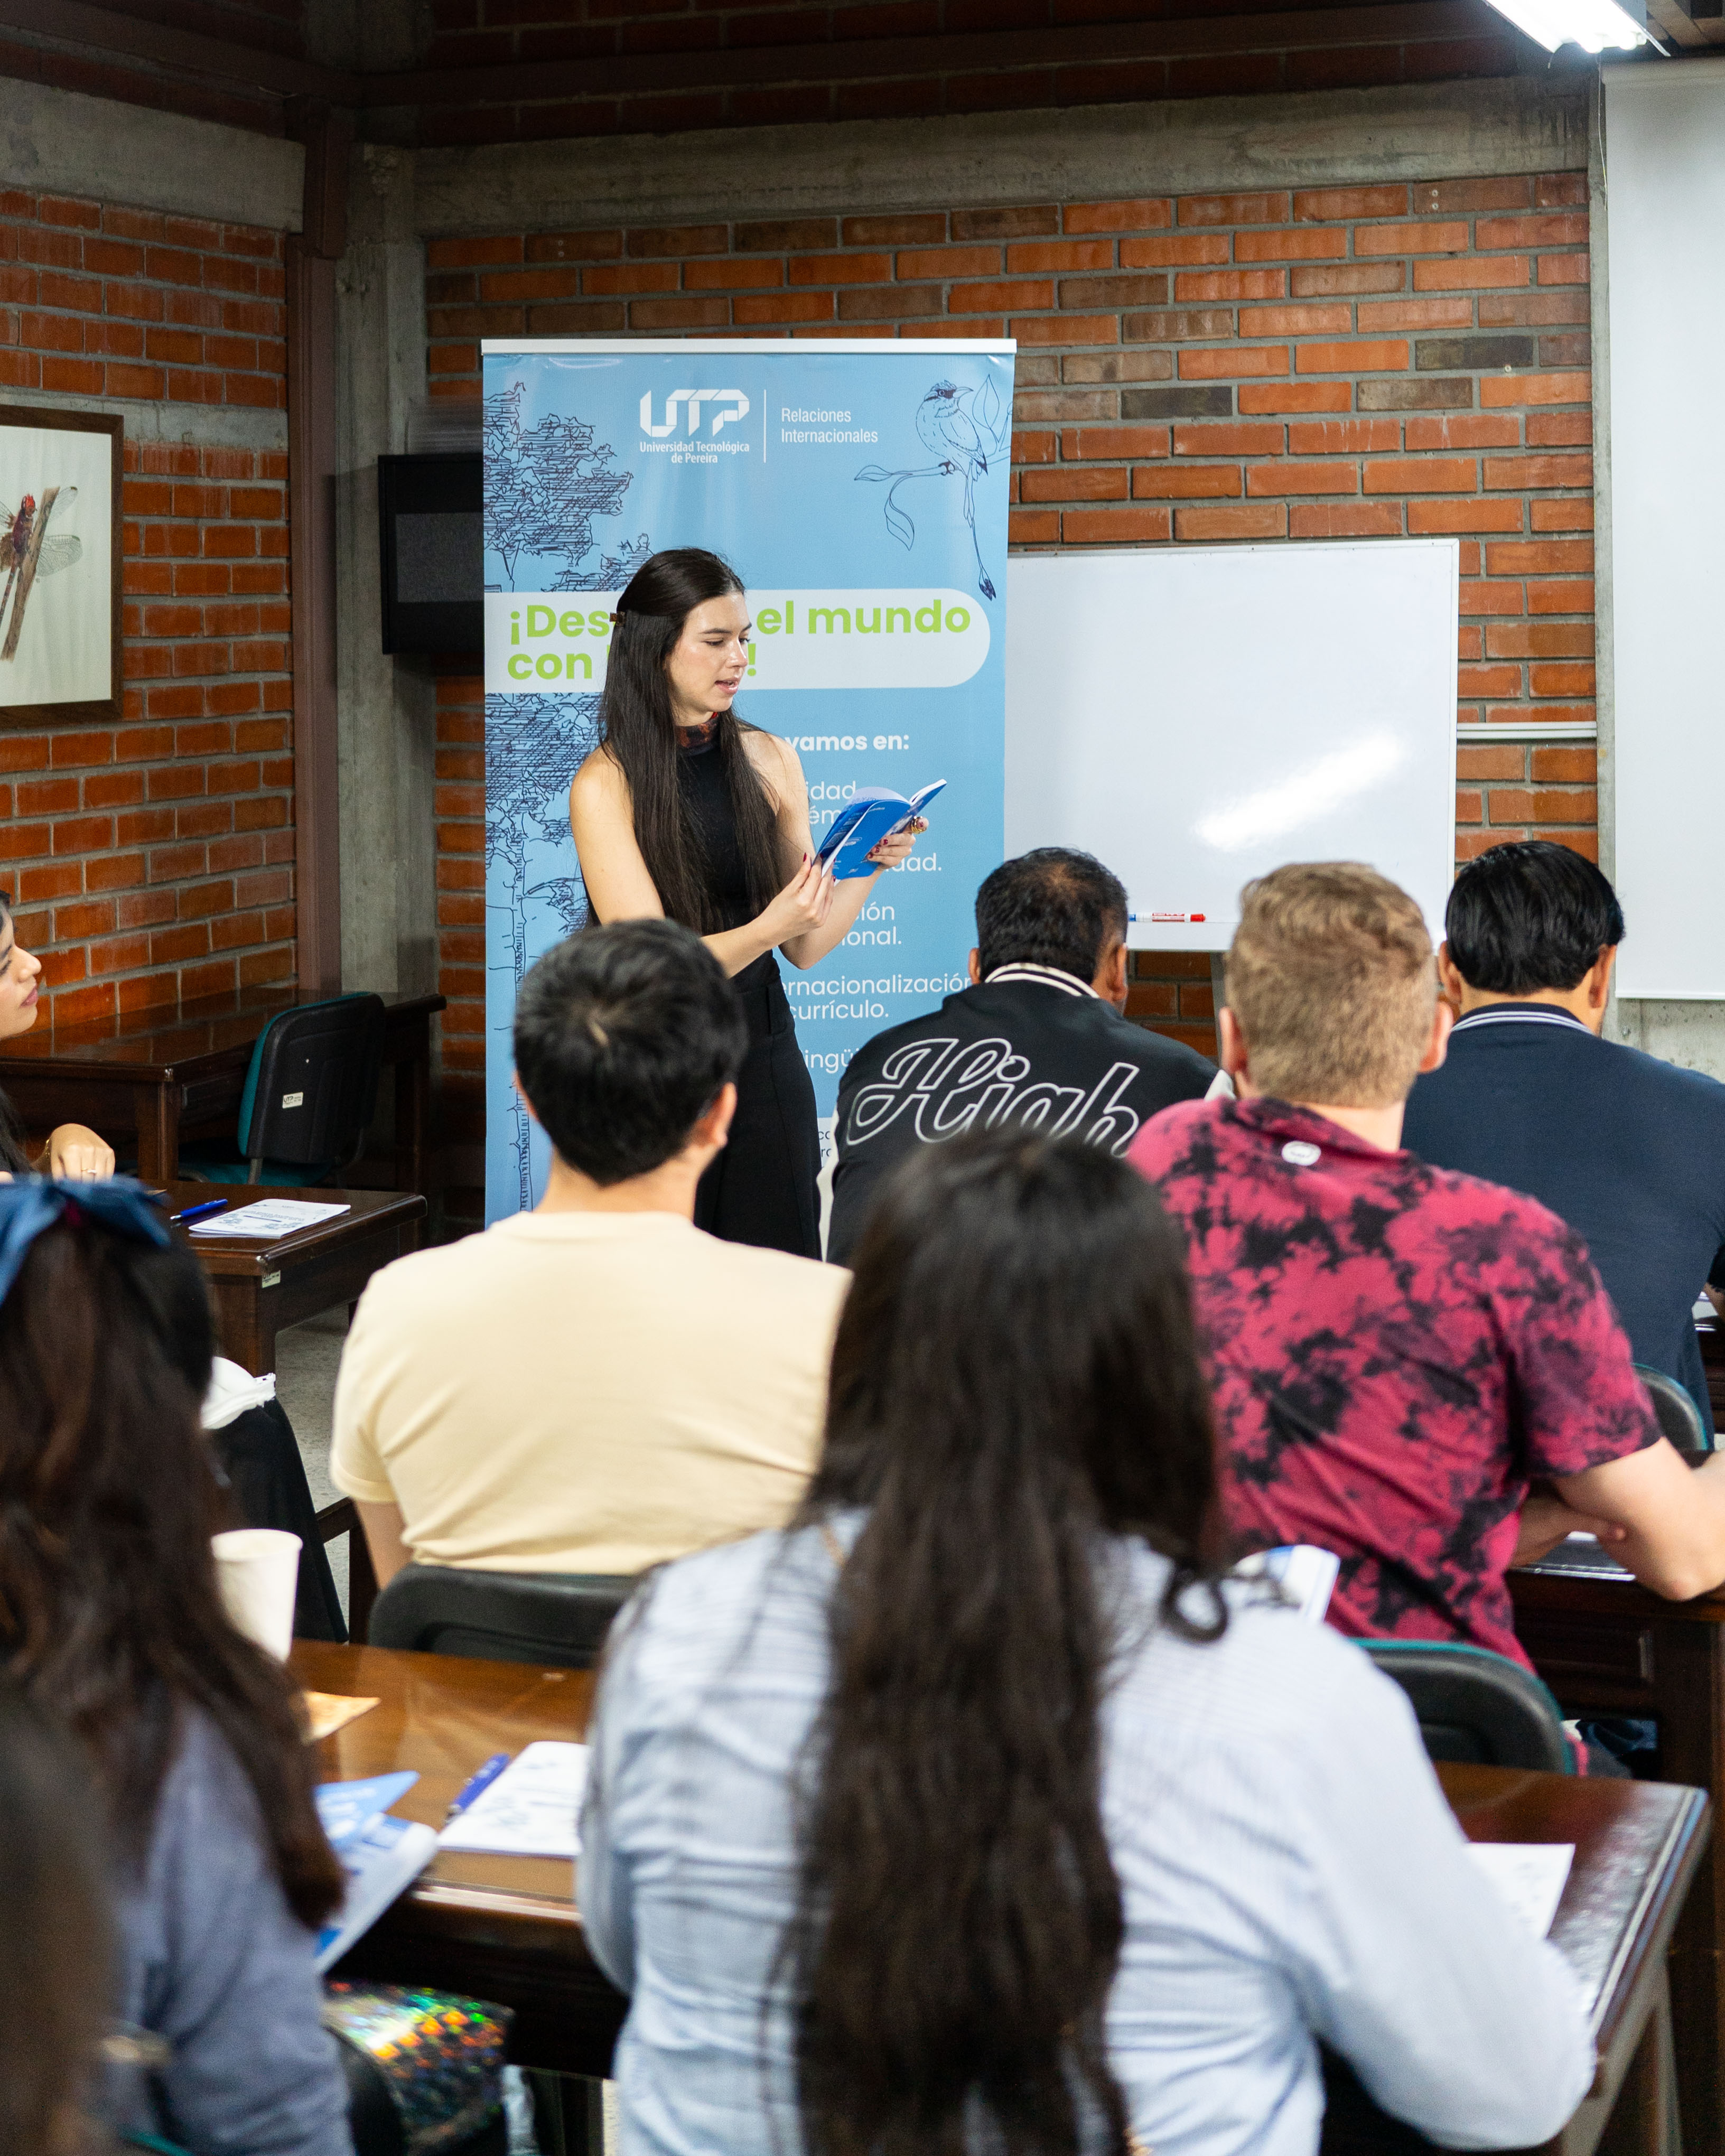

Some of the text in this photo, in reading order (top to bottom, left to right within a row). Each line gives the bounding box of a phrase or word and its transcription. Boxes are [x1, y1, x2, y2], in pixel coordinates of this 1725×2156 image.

[640, 389, 750, 437] UTP
[781, 408, 851, 422] Relaciones
[781, 428, 878, 443] Internacionales
[640, 441, 750, 454] Universidad Tecnológica
[671, 453, 718, 463] de Pereira
[510, 599, 971, 645] ¡Des el mundo
[507, 654, 592, 679] con
[785, 734, 909, 751] vamos en:
[855, 901, 895, 921] ión
[805, 1048, 859, 1074] ingü
